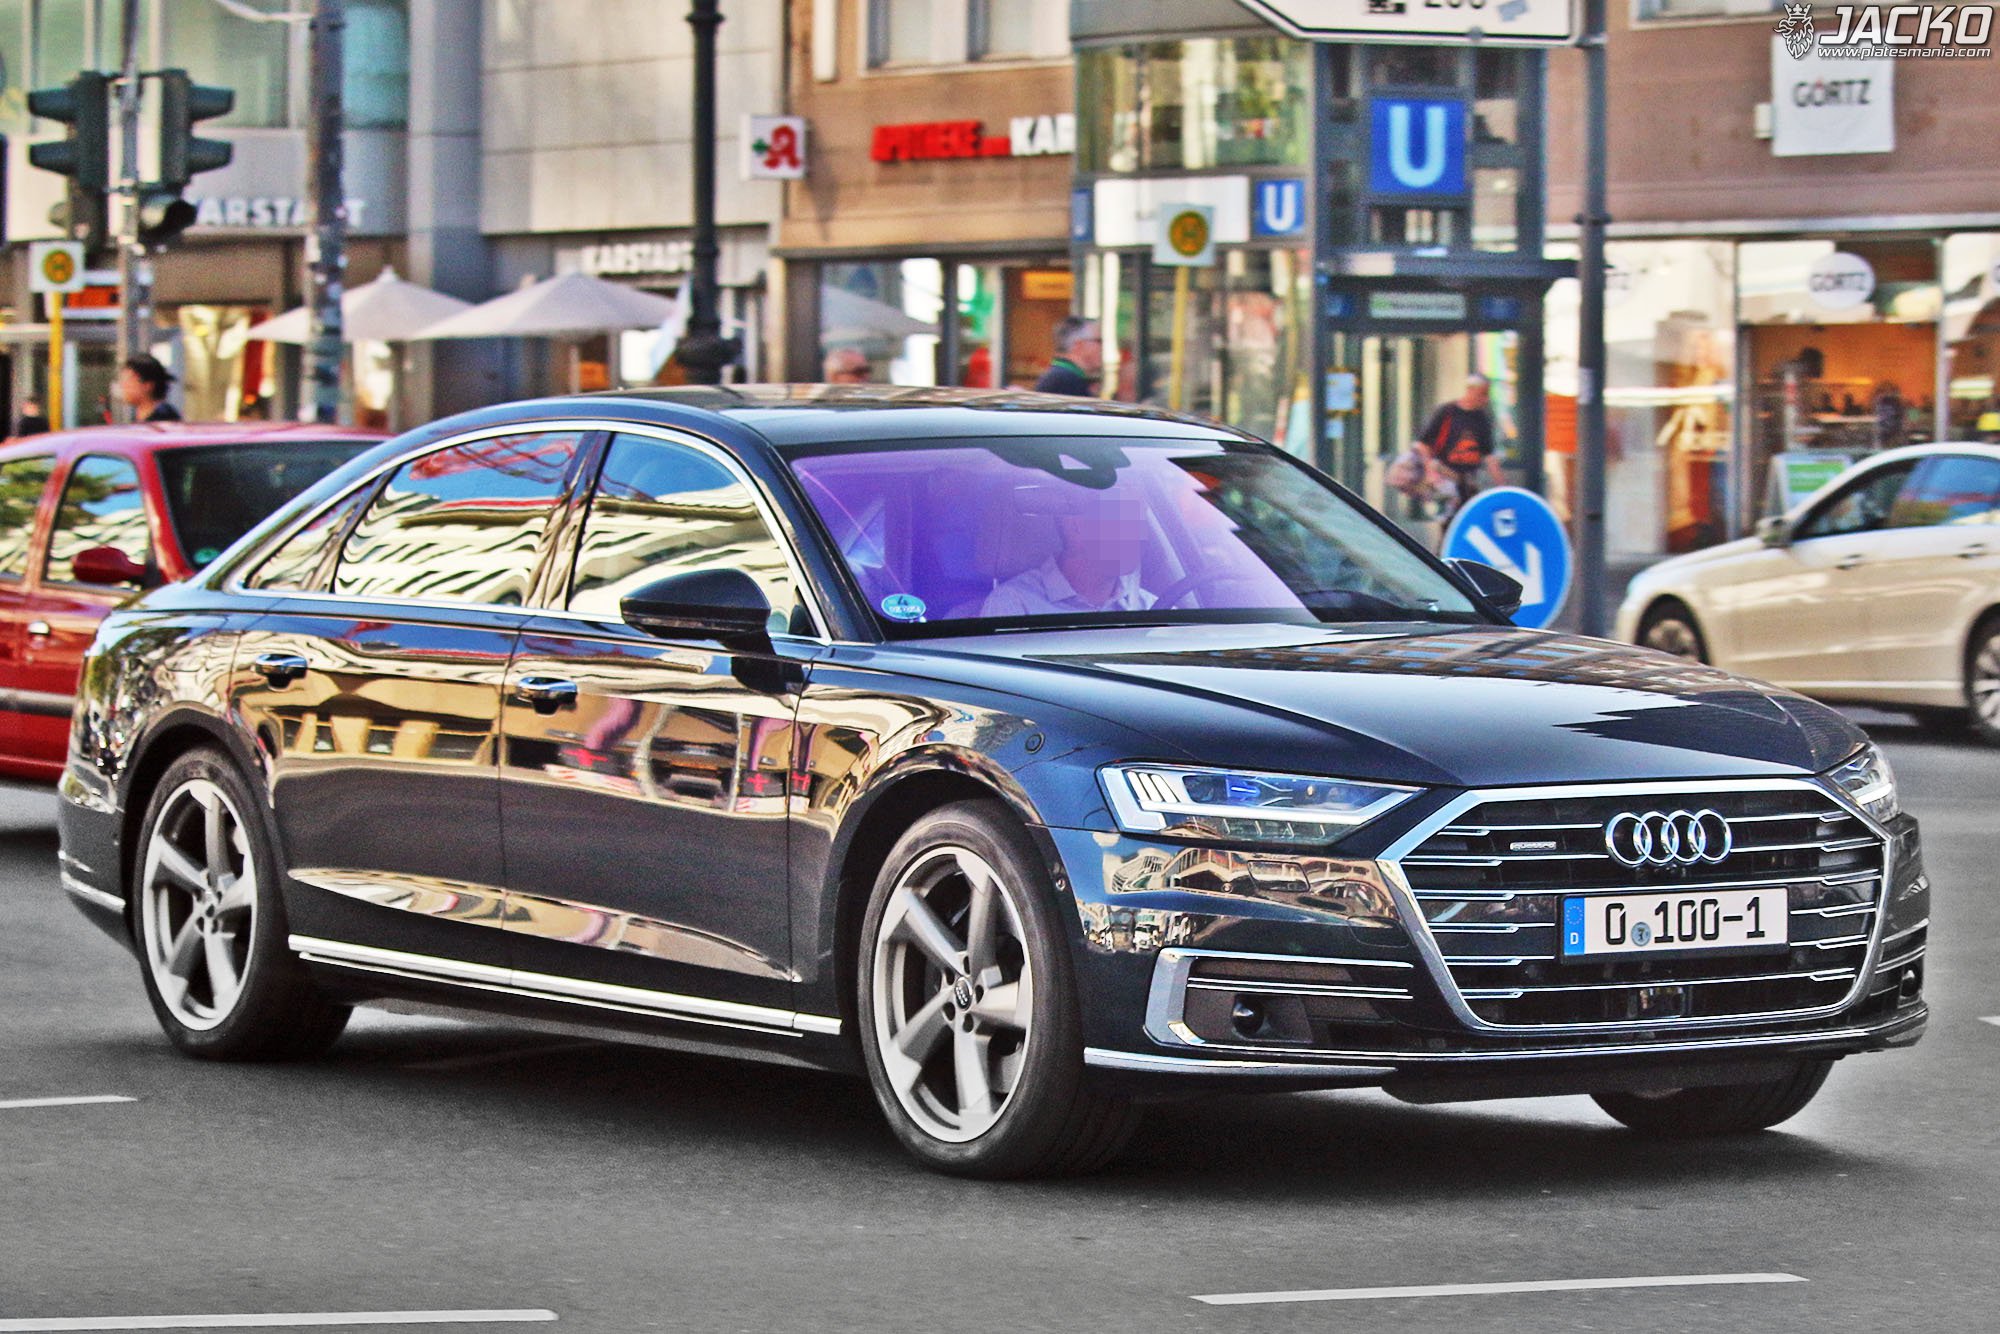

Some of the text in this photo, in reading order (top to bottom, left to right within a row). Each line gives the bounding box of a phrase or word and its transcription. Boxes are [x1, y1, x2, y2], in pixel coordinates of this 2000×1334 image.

[1388, 104, 1446, 188] U
[1264, 184, 1296, 232] U
[1570, 932, 1579, 945] D
[1654, 896, 1766, 944] 100-1
